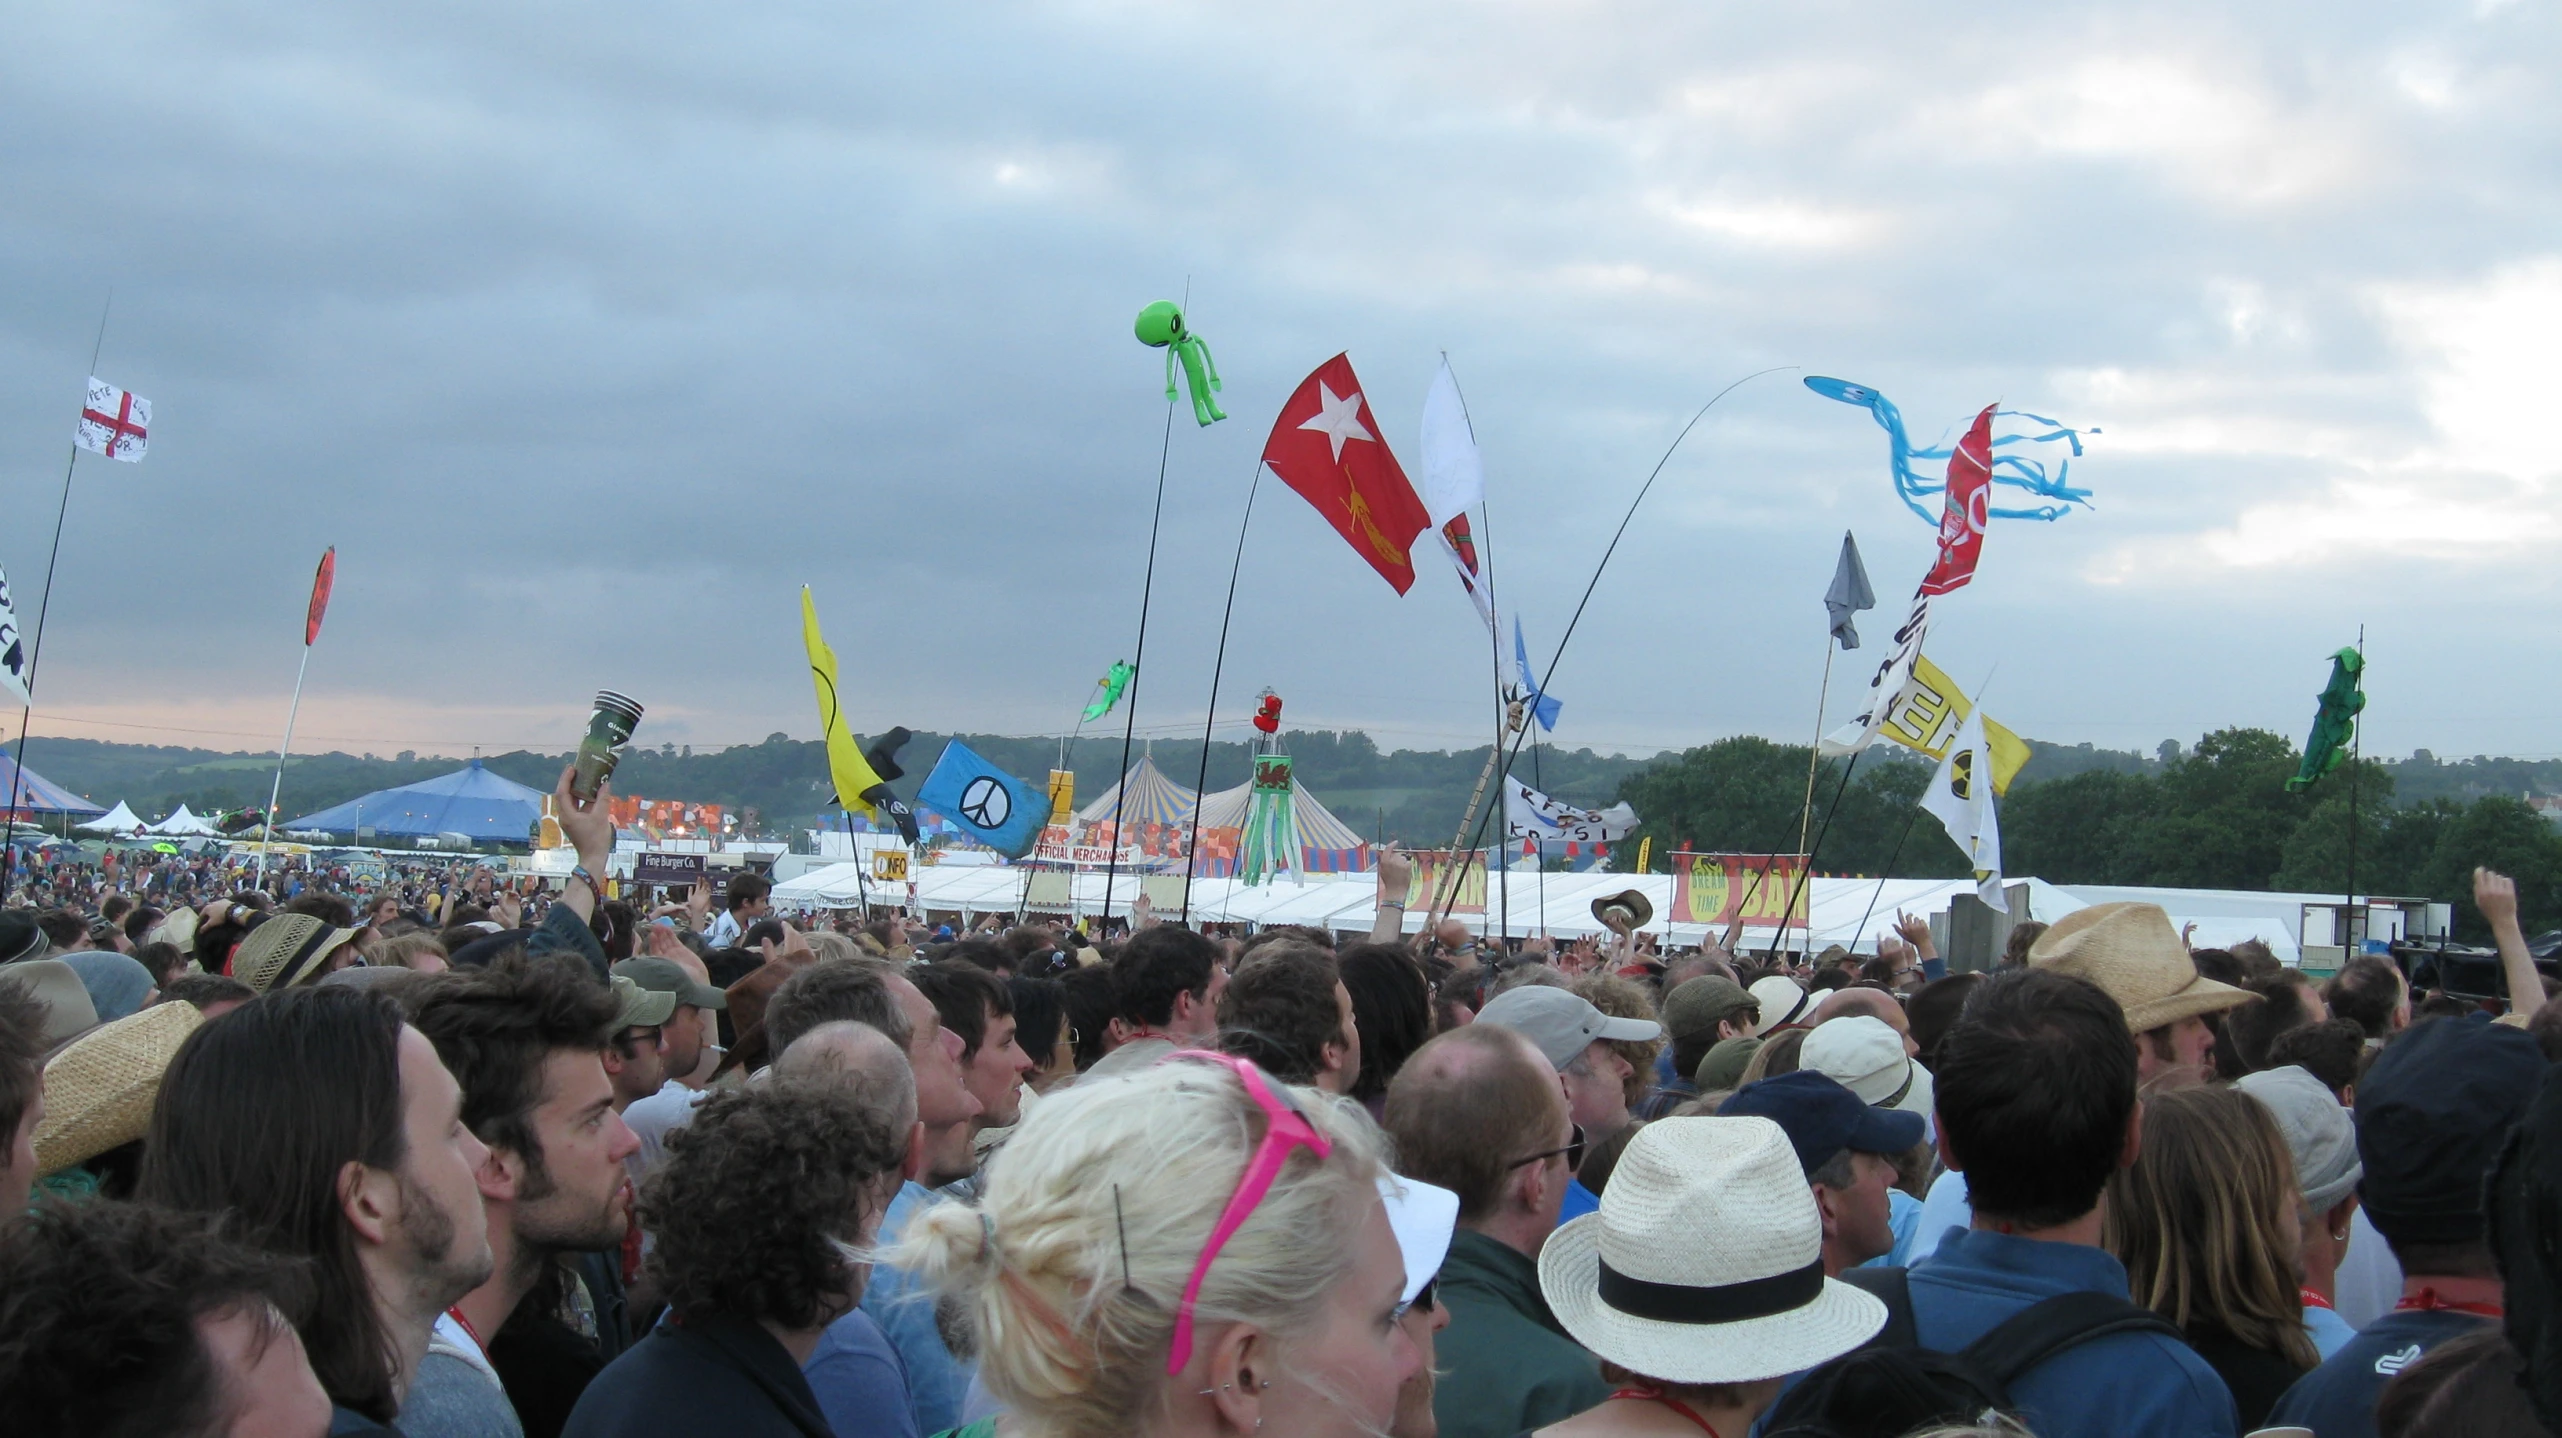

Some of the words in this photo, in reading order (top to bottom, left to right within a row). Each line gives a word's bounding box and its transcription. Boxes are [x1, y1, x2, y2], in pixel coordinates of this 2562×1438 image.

[89, 385, 112, 403] PETE
[103, 434, 132, 452] 208
[1034, 844, 1069, 860] OFFICIAL
[645, 854, 660, 867] Fine
[660, 855, 685, 870] Burger
[684, 856, 696, 869] Co.
[1692, 871, 1726, 889] DREAM
[1738, 868, 1808, 919] BAR
[1696, 894, 1719, 913] TIME
